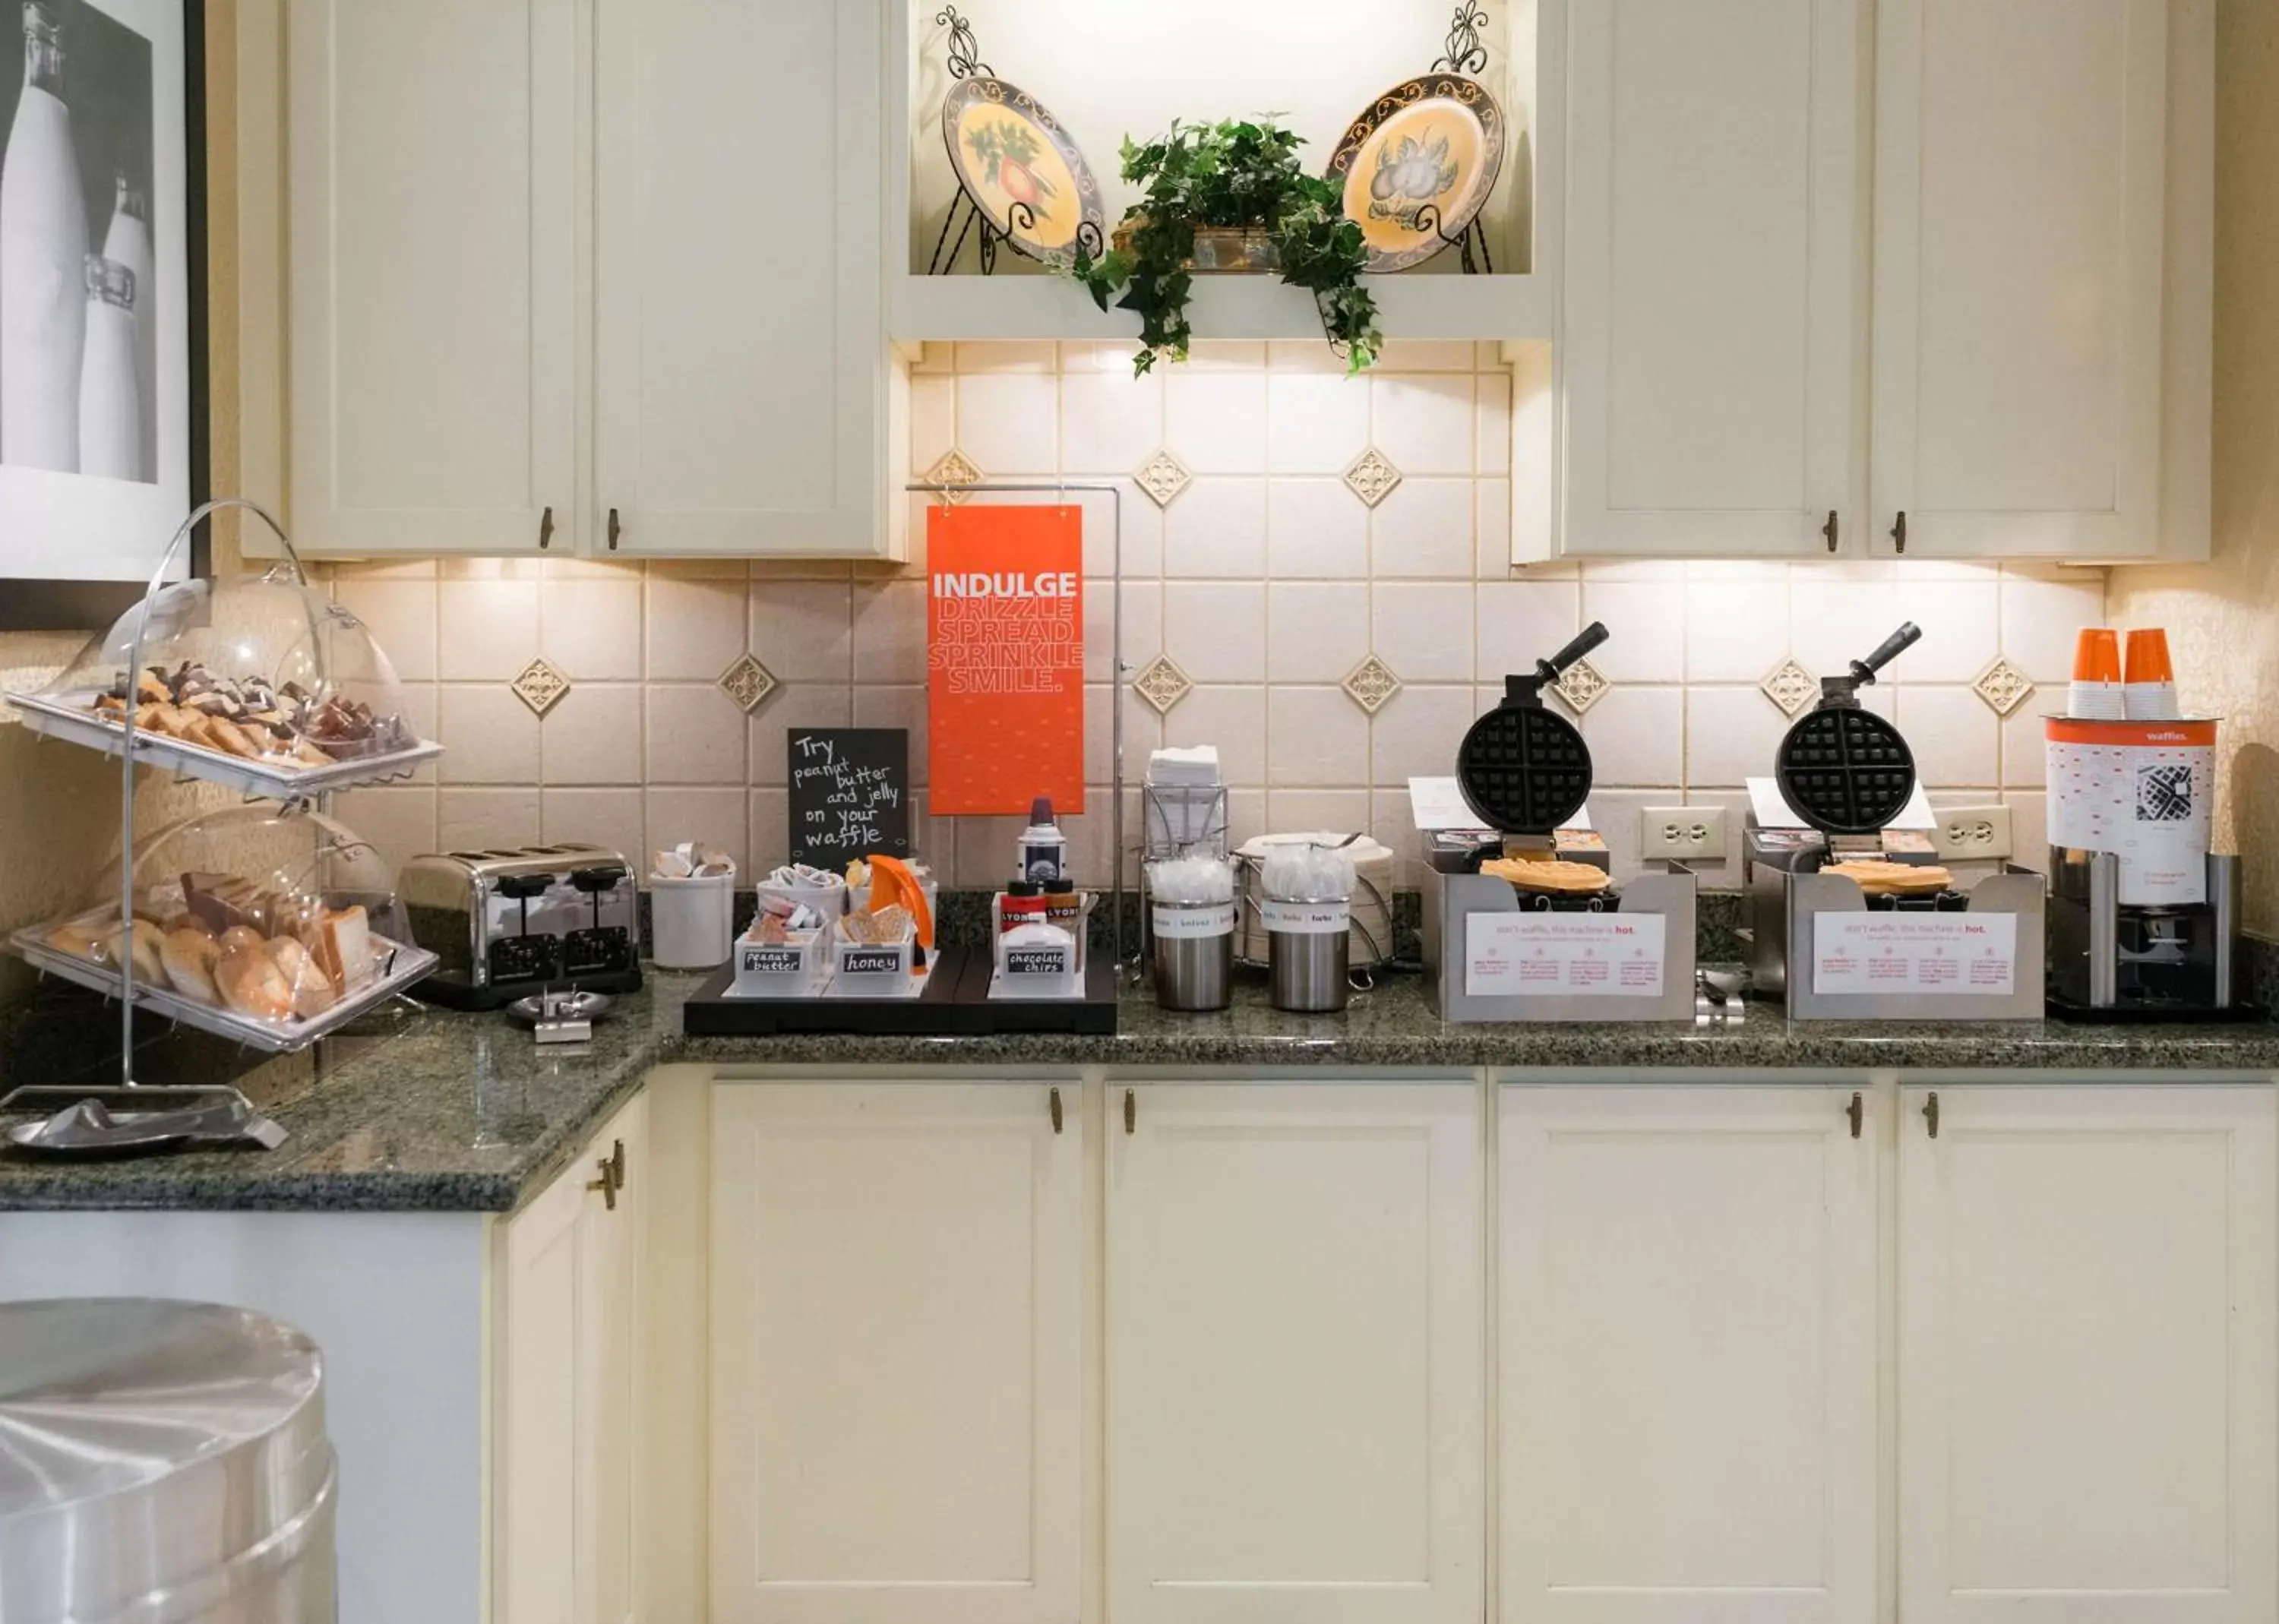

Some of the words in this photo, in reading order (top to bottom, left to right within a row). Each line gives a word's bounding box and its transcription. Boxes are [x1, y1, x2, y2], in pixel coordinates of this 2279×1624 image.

[934, 573, 1076, 598] INDULGE
[938, 596, 1073, 620] DRIZZLE
[937, 619, 1074, 643] SPREAD
[928, 643, 1083, 668] SPRINKLE
[948, 668, 1064, 693] SMILE.
[795, 735, 833, 765] Try
[794, 756, 850, 788] peanut
[836, 766, 892, 789] butter
[827, 787, 858, 804] and
[864, 782, 898, 808] jelly
[805, 810, 825, 823] on
[836, 808, 879, 831] your
[805, 824, 883, 848] waffle
[1002, 913, 1029, 921] LYON
[1047, 908, 1078, 916] LYON
[1965, 924, 1987, 934] hot.
[747, 953, 789, 962] peanut
[753, 960, 798, 971] butter
[847, 954, 896, 971] honey
[1010, 953, 1064, 964] chocolate
